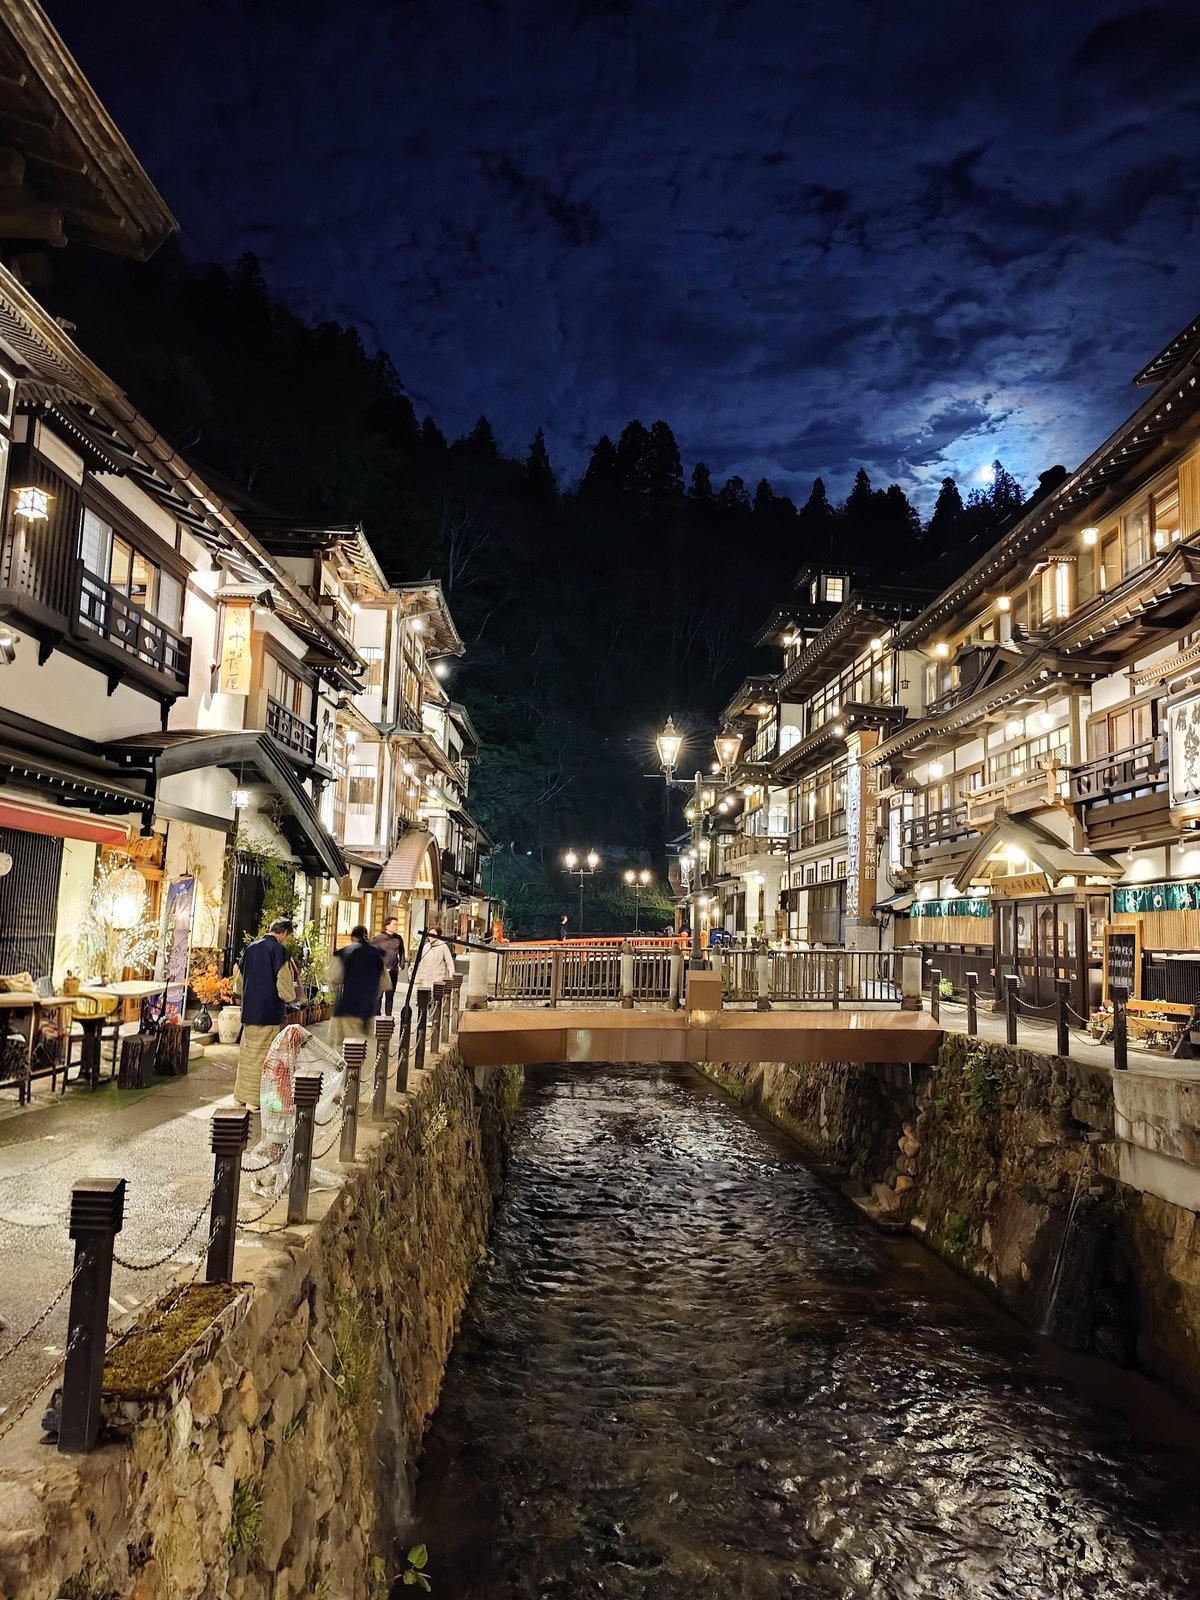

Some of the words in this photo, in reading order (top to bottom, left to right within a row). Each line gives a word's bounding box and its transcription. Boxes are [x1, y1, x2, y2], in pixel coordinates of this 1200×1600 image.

[865, 805, 876, 880] 能登屋旅館
